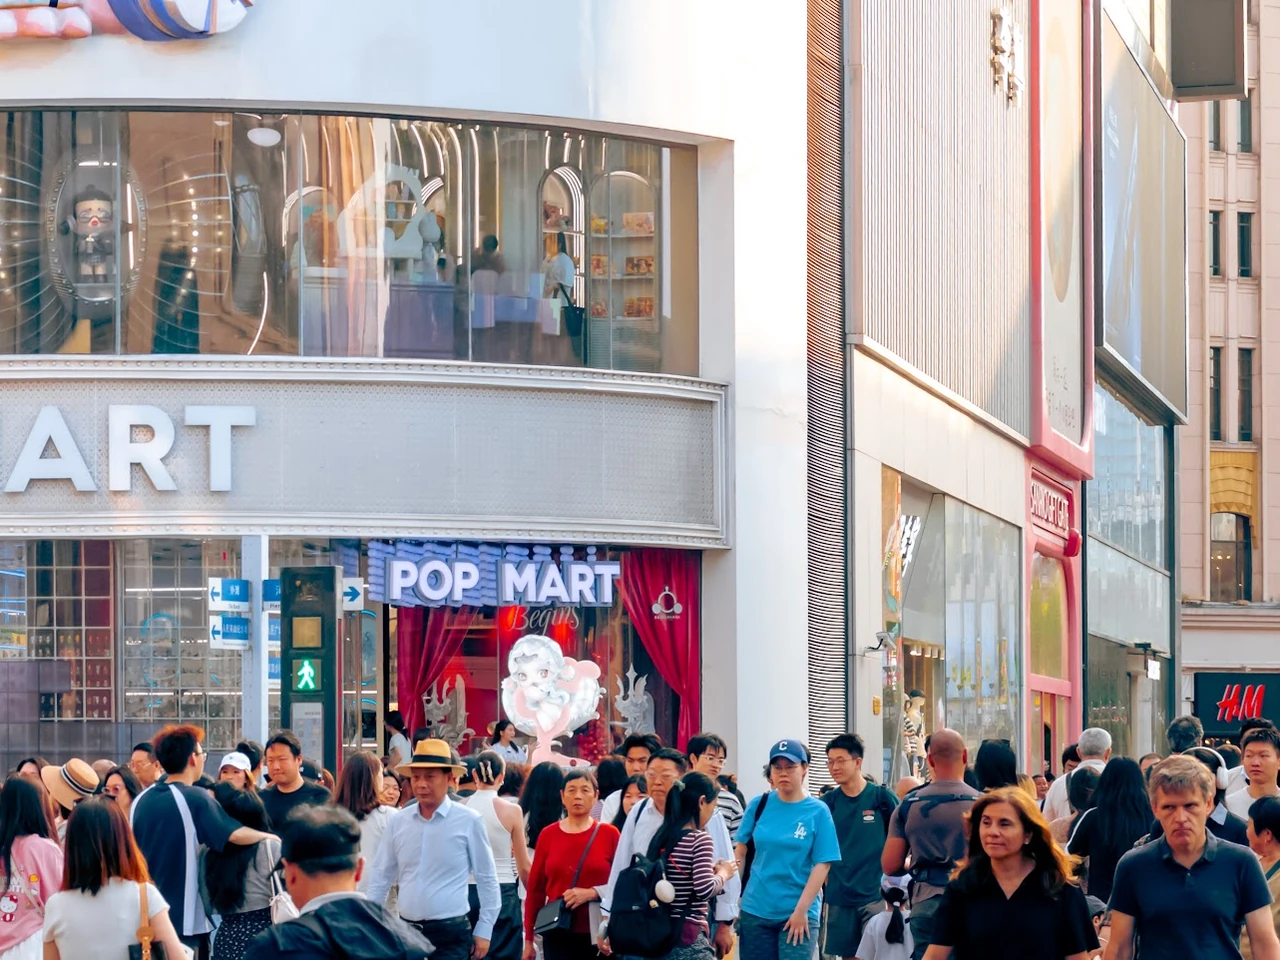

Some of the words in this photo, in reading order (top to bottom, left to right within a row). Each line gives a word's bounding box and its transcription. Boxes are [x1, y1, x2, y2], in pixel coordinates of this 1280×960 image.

[388, 557, 480, 603] POP
[501, 559, 620, 604] MART
[1216, 684, 1265, 722] H&M
[778, 741, 788, 751] C
[794, 822, 807, 840] LA
